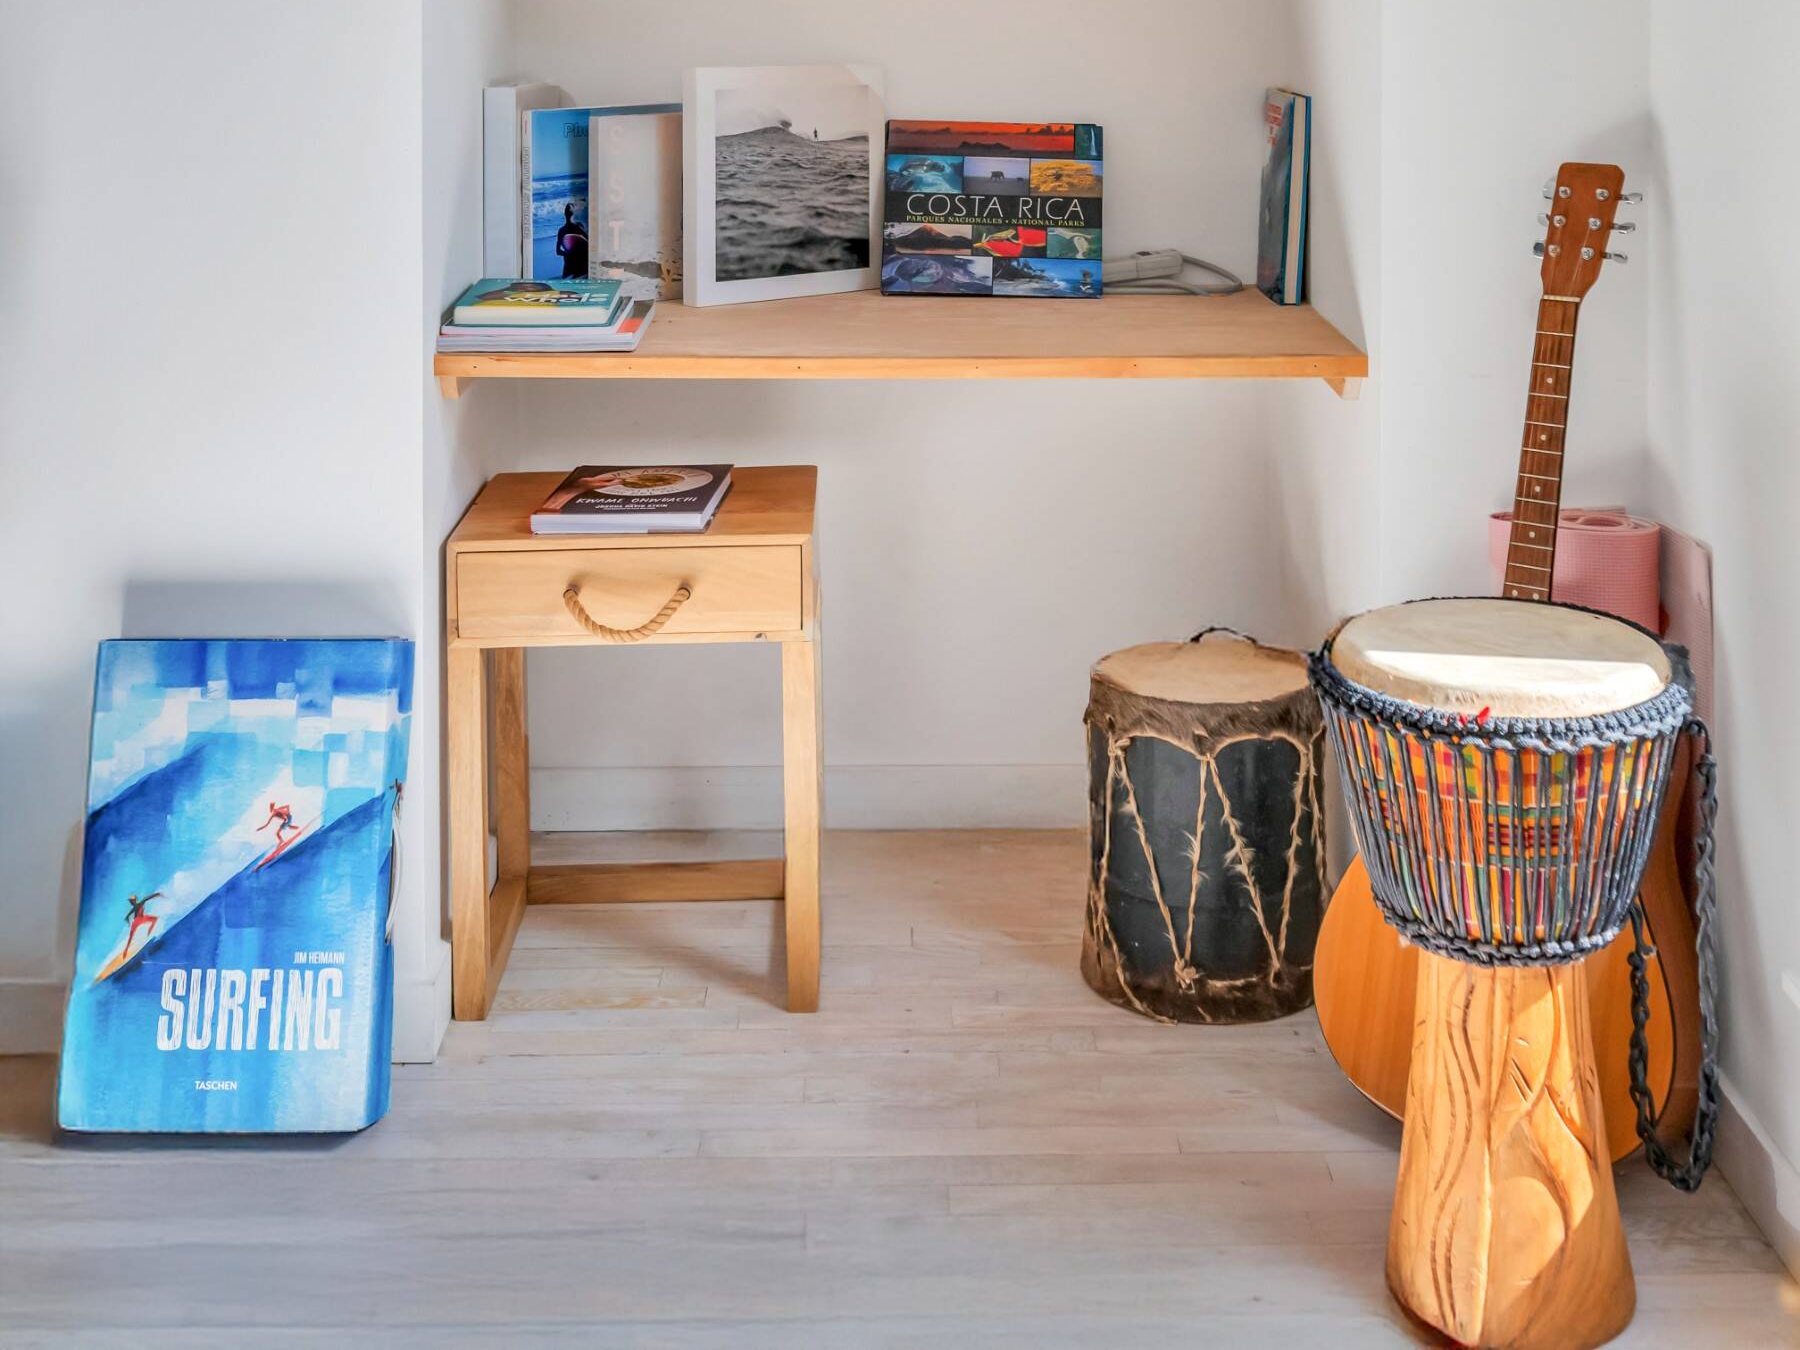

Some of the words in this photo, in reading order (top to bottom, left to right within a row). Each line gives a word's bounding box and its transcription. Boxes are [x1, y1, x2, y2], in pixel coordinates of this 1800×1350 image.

[907, 194, 1003, 217] COSTA
[1018, 197, 1085, 221] RICA
[906, 215, 945, 223] PARQUES
[948, 216, 1003, 224] NACIONALES
[1011, 218, 1055, 226] NATIONAL
[293, 953, 307, 964] JIM
[309, 952, 345, 964] HEIMANN
[157, 967, 343, 1051] SURFING
[194, 1081, 238, 1091] TASCHEN
